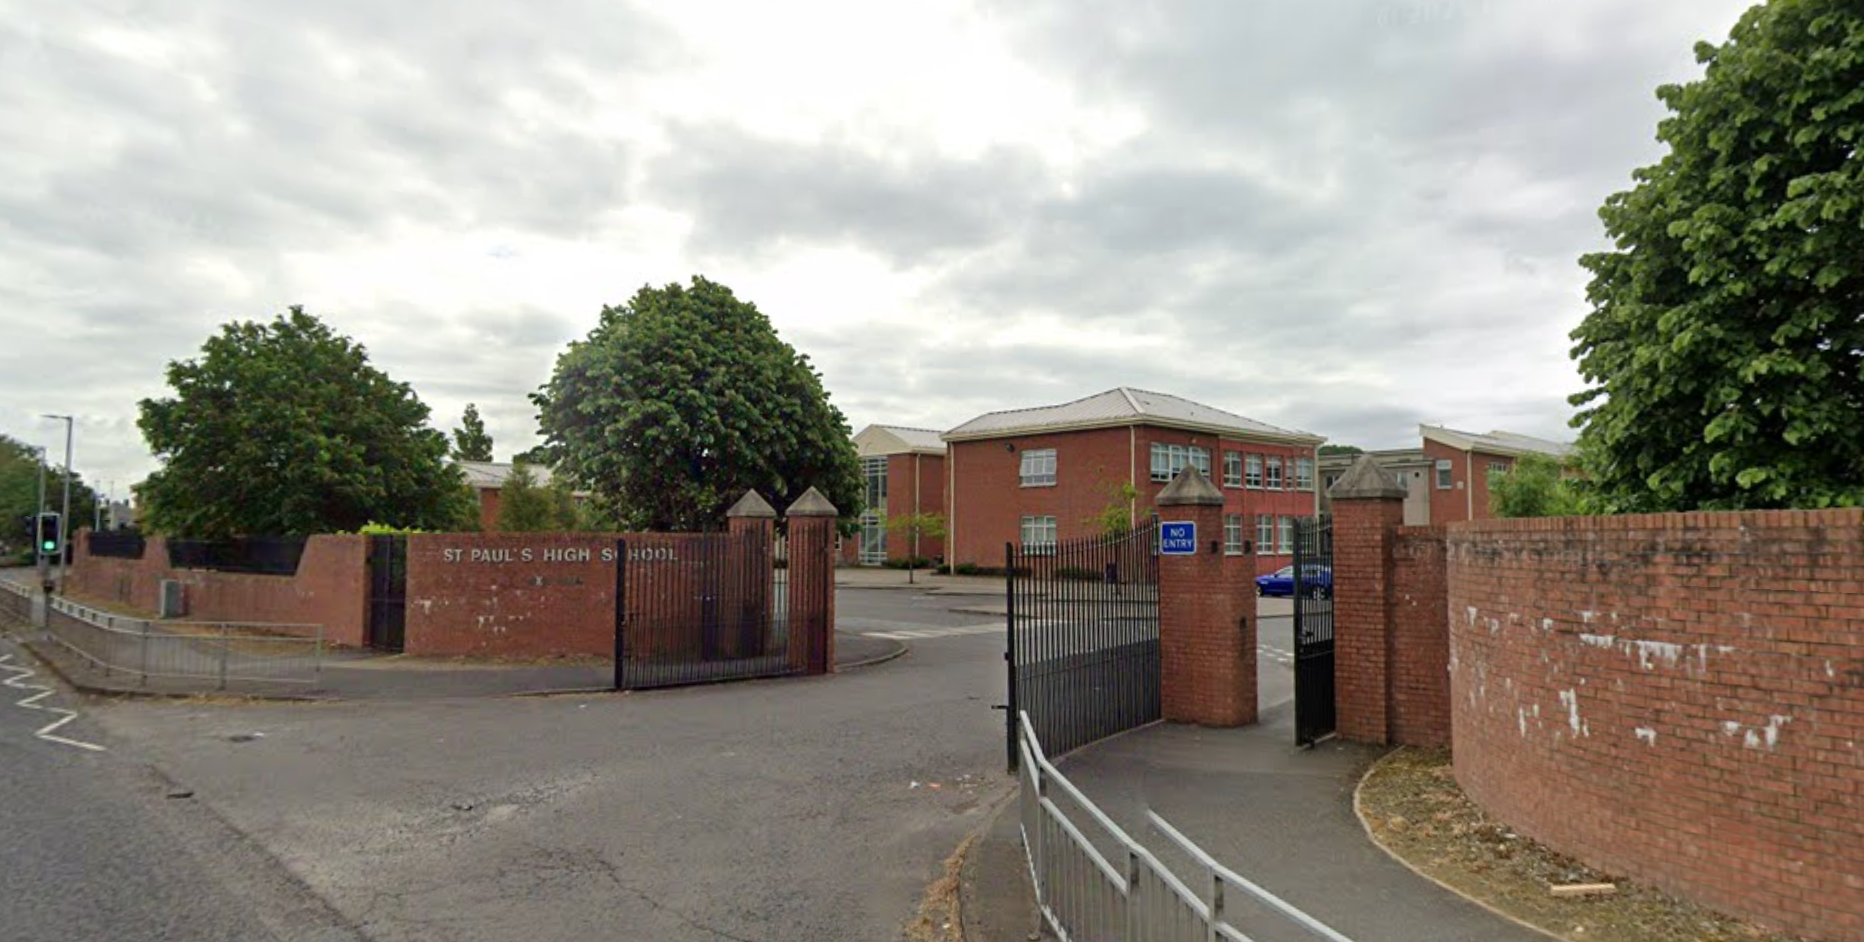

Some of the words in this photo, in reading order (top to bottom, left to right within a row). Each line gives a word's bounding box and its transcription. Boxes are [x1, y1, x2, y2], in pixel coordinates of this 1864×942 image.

[1170, 527, 1185, 538] NO
[1163, 538, 1193, 549] ENTRY
[443, 548, 463, 563] ST
[470, 547, 533, 563] PAUL'S
[543, 547, 591, 562] HIGH
[601, 547, 679, 562] SHOOL
